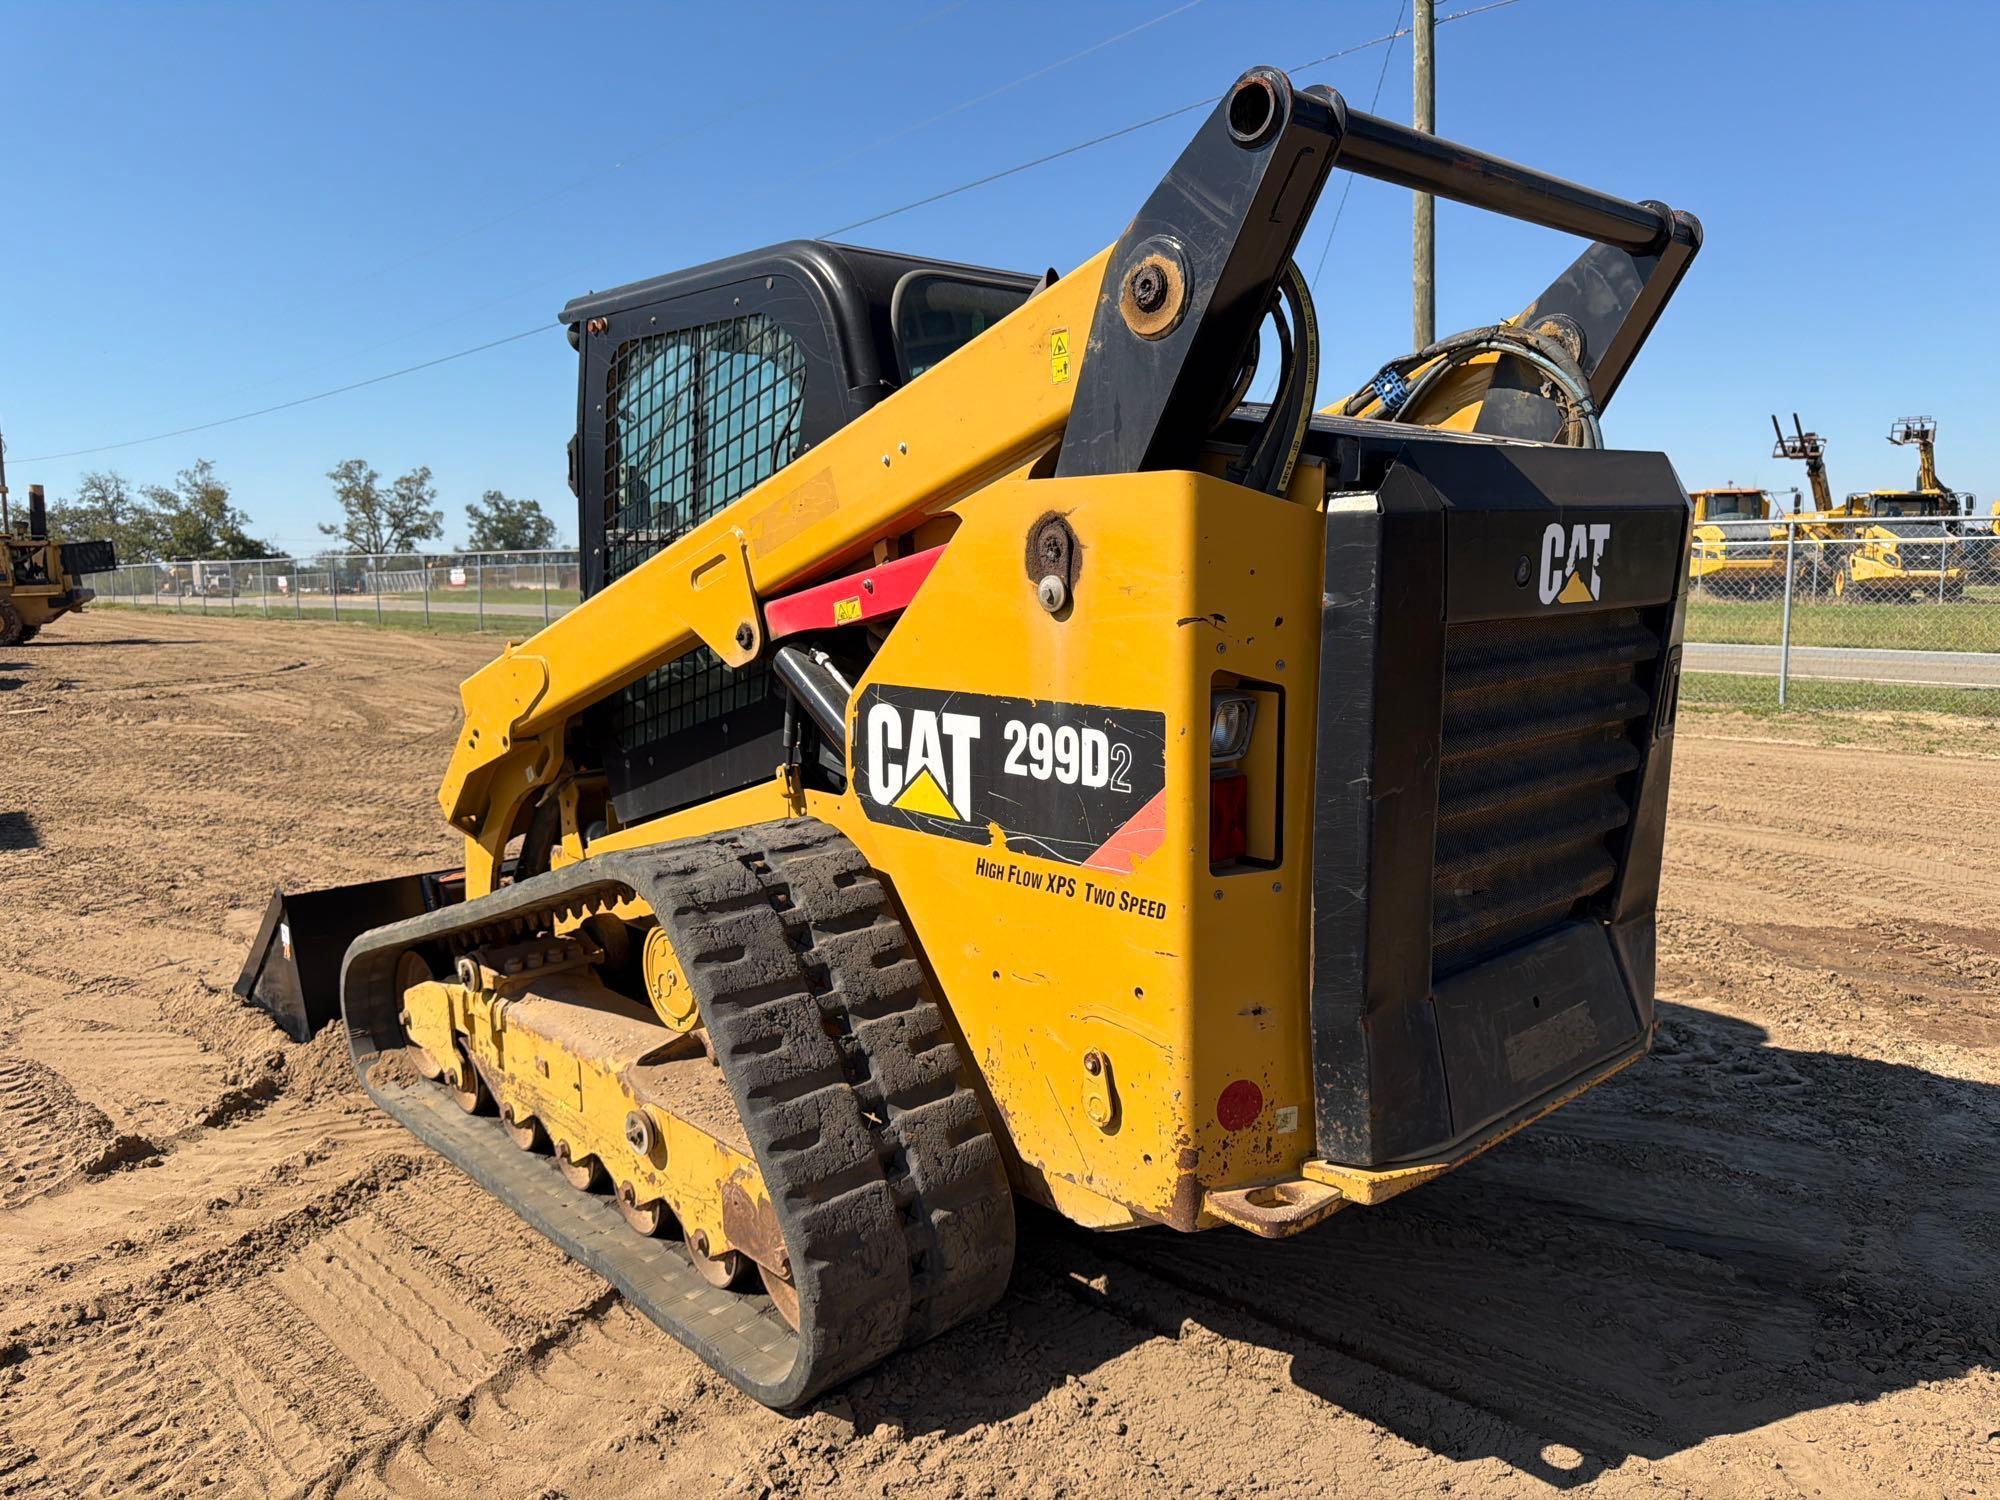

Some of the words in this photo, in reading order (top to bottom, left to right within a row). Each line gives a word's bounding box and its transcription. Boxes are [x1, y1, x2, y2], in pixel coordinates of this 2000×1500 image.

[1538, 522, 1611, 605] CAT
[867, 703, 981, 822] CAT
[1046, 872, 1077, 898] XPS
